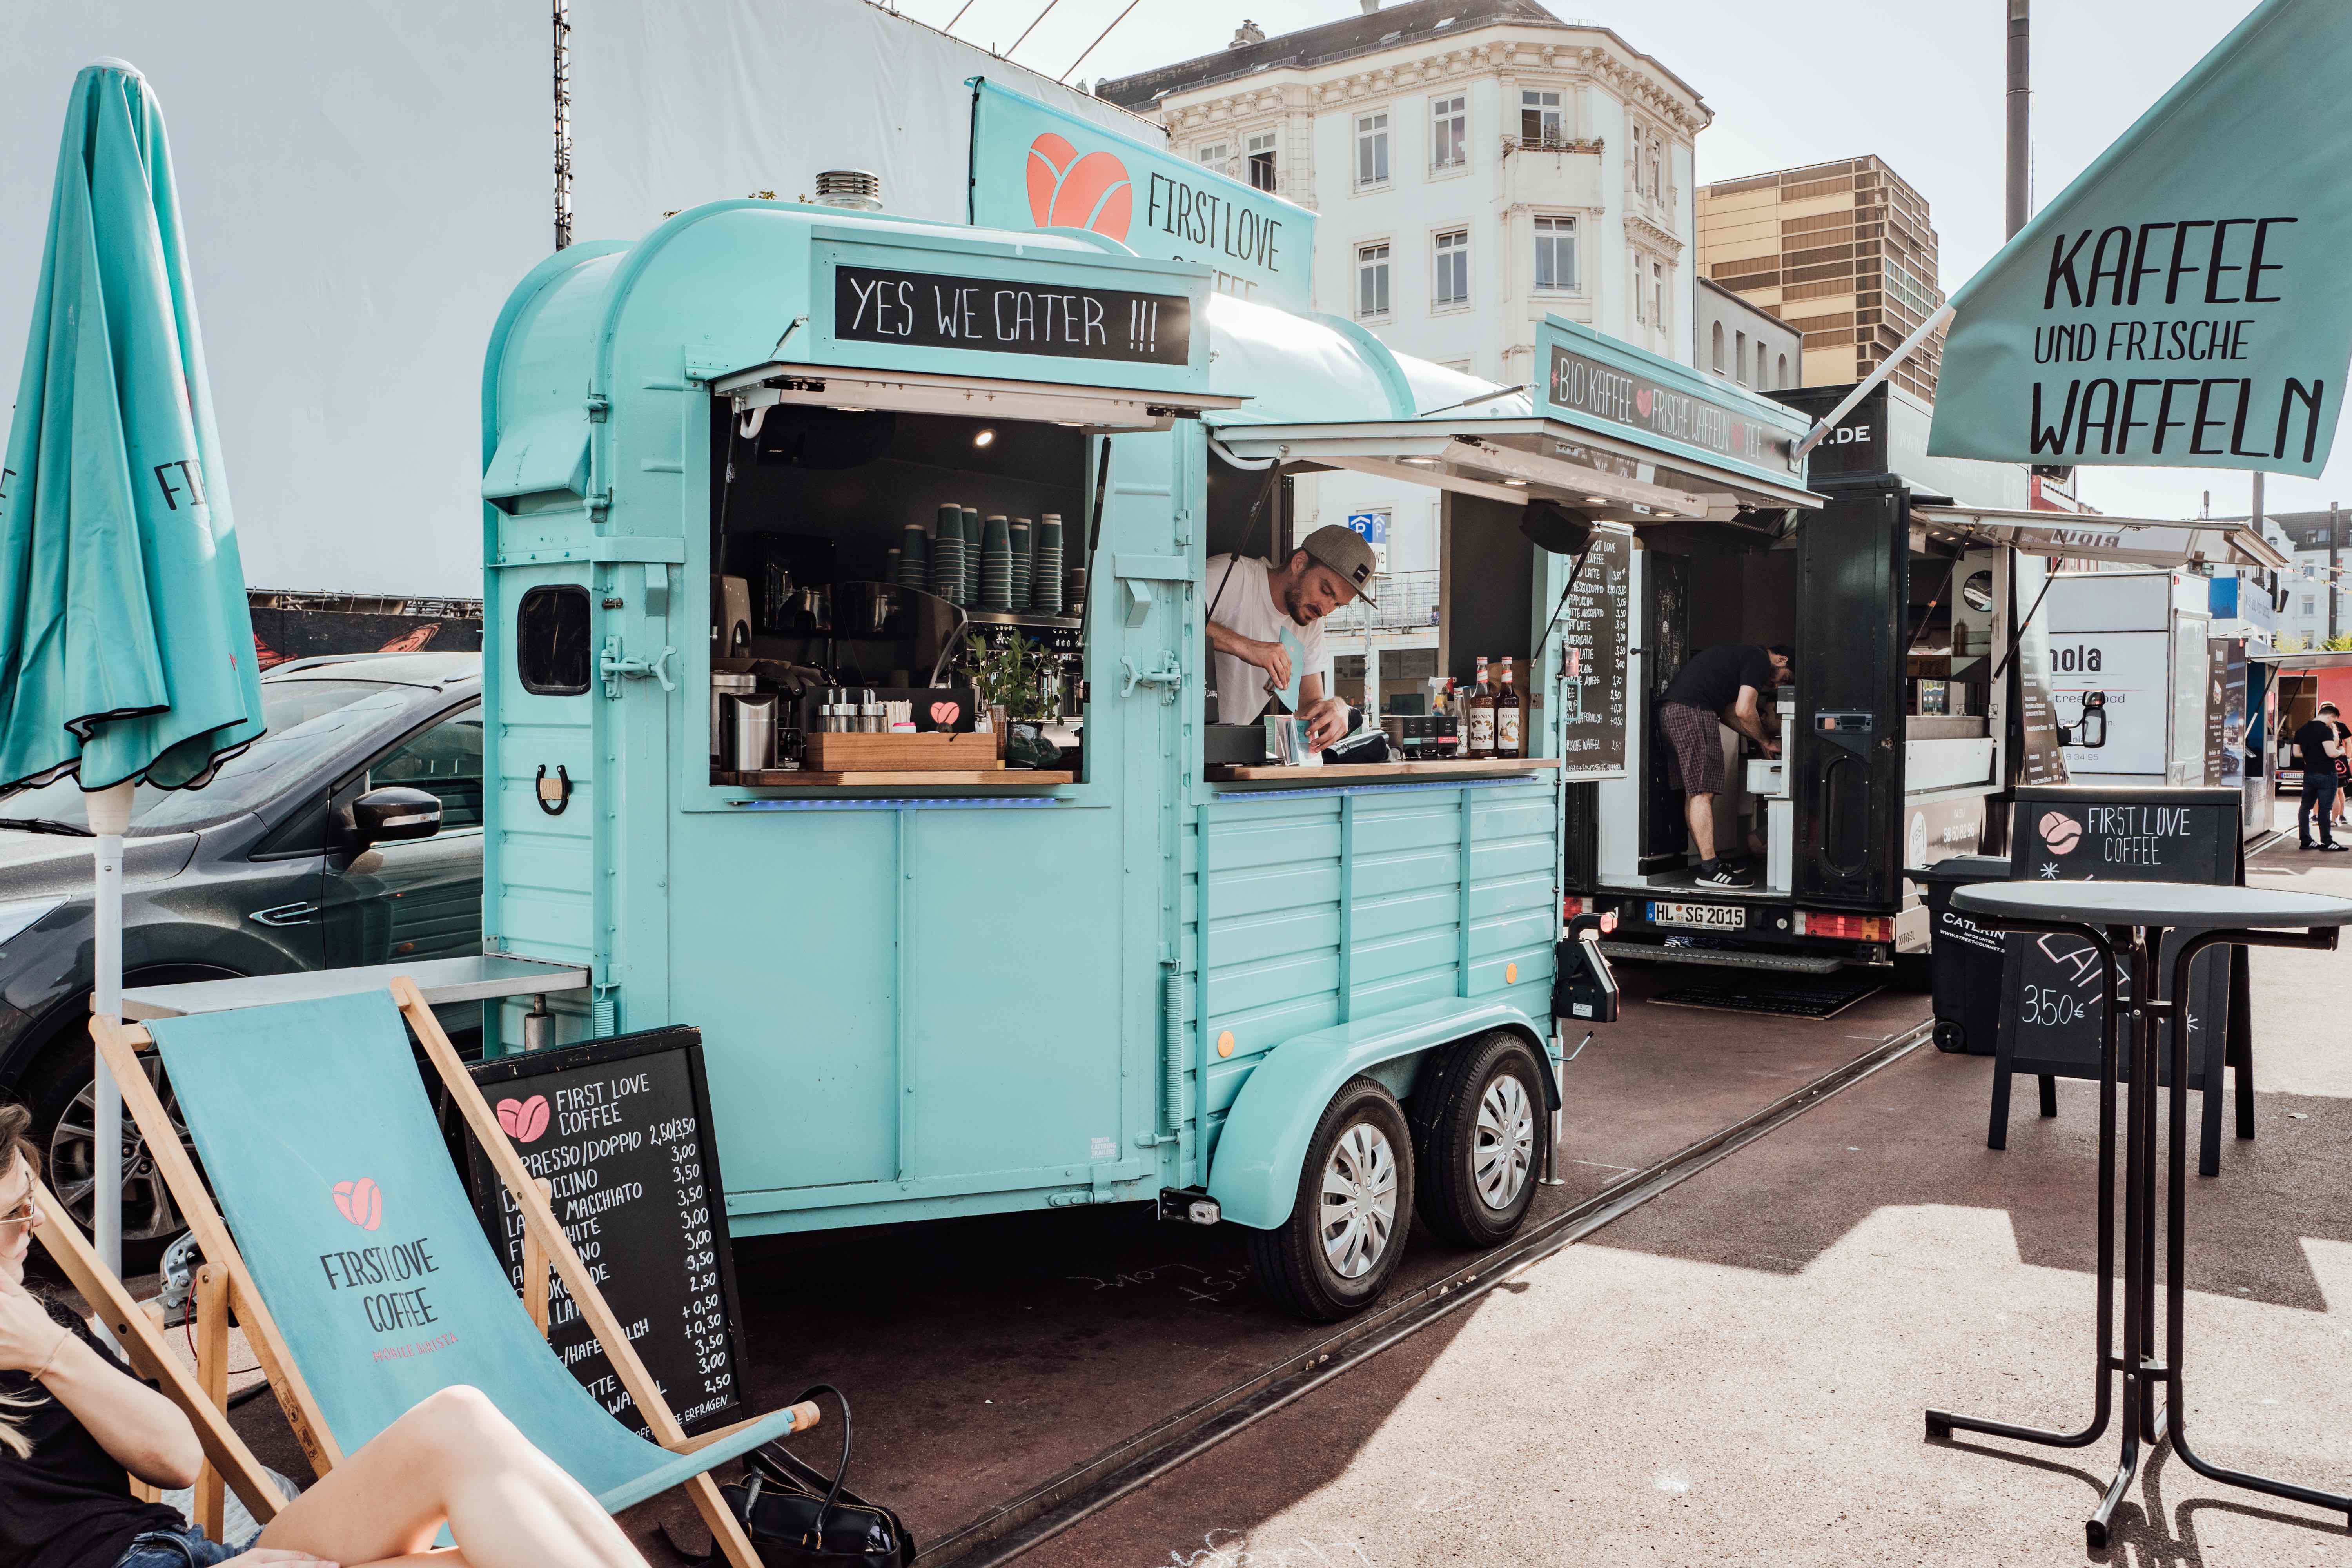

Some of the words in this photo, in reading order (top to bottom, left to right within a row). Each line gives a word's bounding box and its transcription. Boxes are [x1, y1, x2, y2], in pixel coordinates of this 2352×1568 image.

[1149, 172, 1220, 249] FIRST
[1225, 202, 1282, 272] LOVE
[2044, 217, 2298, 309] KAFFEE
[850, 278, 914, 336] YES
[935, 286, 982, 338] WE
[995, 291, 1106, 346] CATER
[1130, 300, 1158, 352] !!!
[2034, 323, 2097, 364] UND
[2106, 320, 2255, 361] FRISCHE
[1560, 357, 1584, 405] BIO
[1589, 367, 1633, 423] KAFFEE
[1652, 388, 1689, 439] FRISCHE
[1691, 401, 1730, 452] WAFFELN
[1744, 423, 1763, 459] TEE
[2030, 377, 2324, 463] WAFFELN
[1376, 523, 1382, 539] P
[1588, 552, 1604, 564] COFFEE
[1604, 542, 1616, 553] LOVE
[1585, 568, 1600, 579] LATTE
[1568, 594, 1594, 607] APPUCCINO
[1615, 609, 1626, 619] 3,50
[1577, 620, 1591, 631] WHITE
[1615, 620, 1626, 631] 3,50
[1568, 635, 1593, 646] MERICANO
[1616, 633, 1626, 644] 3,00
[1579, 648, 1594, 660] LATTE
[1615, 646, 1626, 657] 3,50
[1615, 659, 1625, 670] 3,00
[1584, 675, 1601, 686] MINZE
[1566, 739, 1582, 752] RISCHE
[1583, 738, 1601, 750] WAFFEL
[1944, 827, 1951, 843] 58
[1952, 825, 1959, 841] 60
[1960, 824, 1967, 839] 82
[1967, 822, 1975, 837] 96
[2088, 807, 2136, 836] FIRST
[2143, 808, 2190, 837] LOVE
[2105, 835, 2161, 865] COFFEE
[1656, 904, 1673, 920] HL
[1685, 907, 1703, 922] SG
[1707, 908, 1743, 926] 2015
[556, 1082, 604, 1112] FIRST
[612, 1073, 650, 1098] LOVE
[559, 1102, 622, 1136] COFFEE
[519, 1131, 642, 1177] PRESSO/DOPPIO
[671, 1143, 696, 1164] 3,00
[566, 1182, 642, 1220] MACCHIATO
[673, 1164, 700, 1185] 3,50
[677, 1185, 703, 1207] 3,50
[681, 1207, 709, 1229] 3,00
[684, 1230, 711, 1250] 3,00
[319, 1247, 390, 1290] FIRST
[383, 1238, 439, 1282] LOVE
[687, 1252, 714, 1272] 3,50
[690, 1272, 716, 1292] 2,50
[363, 1287, 438, 1333] COFFEE
[373, 1344, 414, 1363] MOBILE
[416, 1332, 459, 1355] BARISTA
[695, 1333, 724, 1356] 3,50
[699, 1352, 726, 1374] 3,00
[704, 1373, 731, 1393] 2,50
[685, 1394, 728, 1422] ERFRAGEN
